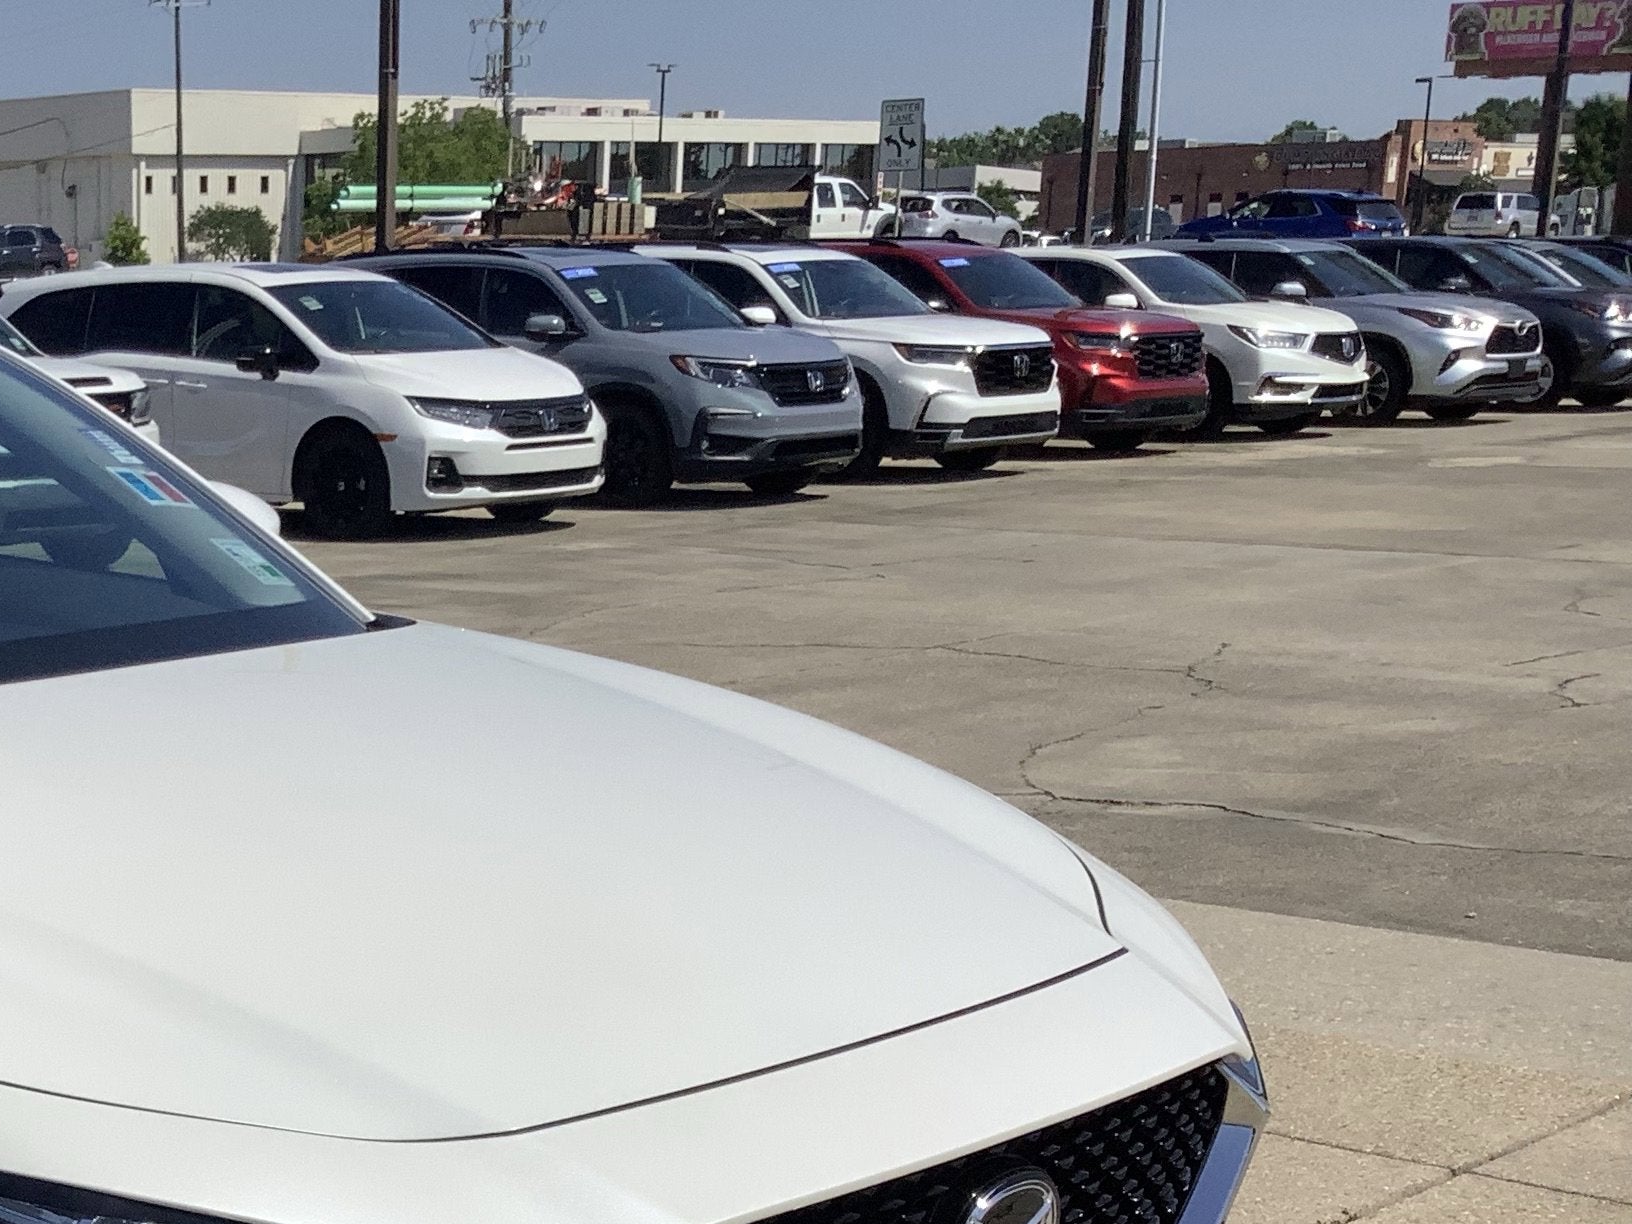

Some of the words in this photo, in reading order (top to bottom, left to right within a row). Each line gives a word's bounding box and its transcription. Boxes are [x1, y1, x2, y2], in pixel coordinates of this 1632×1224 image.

[1488, 5, 1554, 32] RUFF
[885, 102, 920, 113] CENTER
[889, 114, 914, 123] LANE
[886, 159, 912, 168] ONLY
